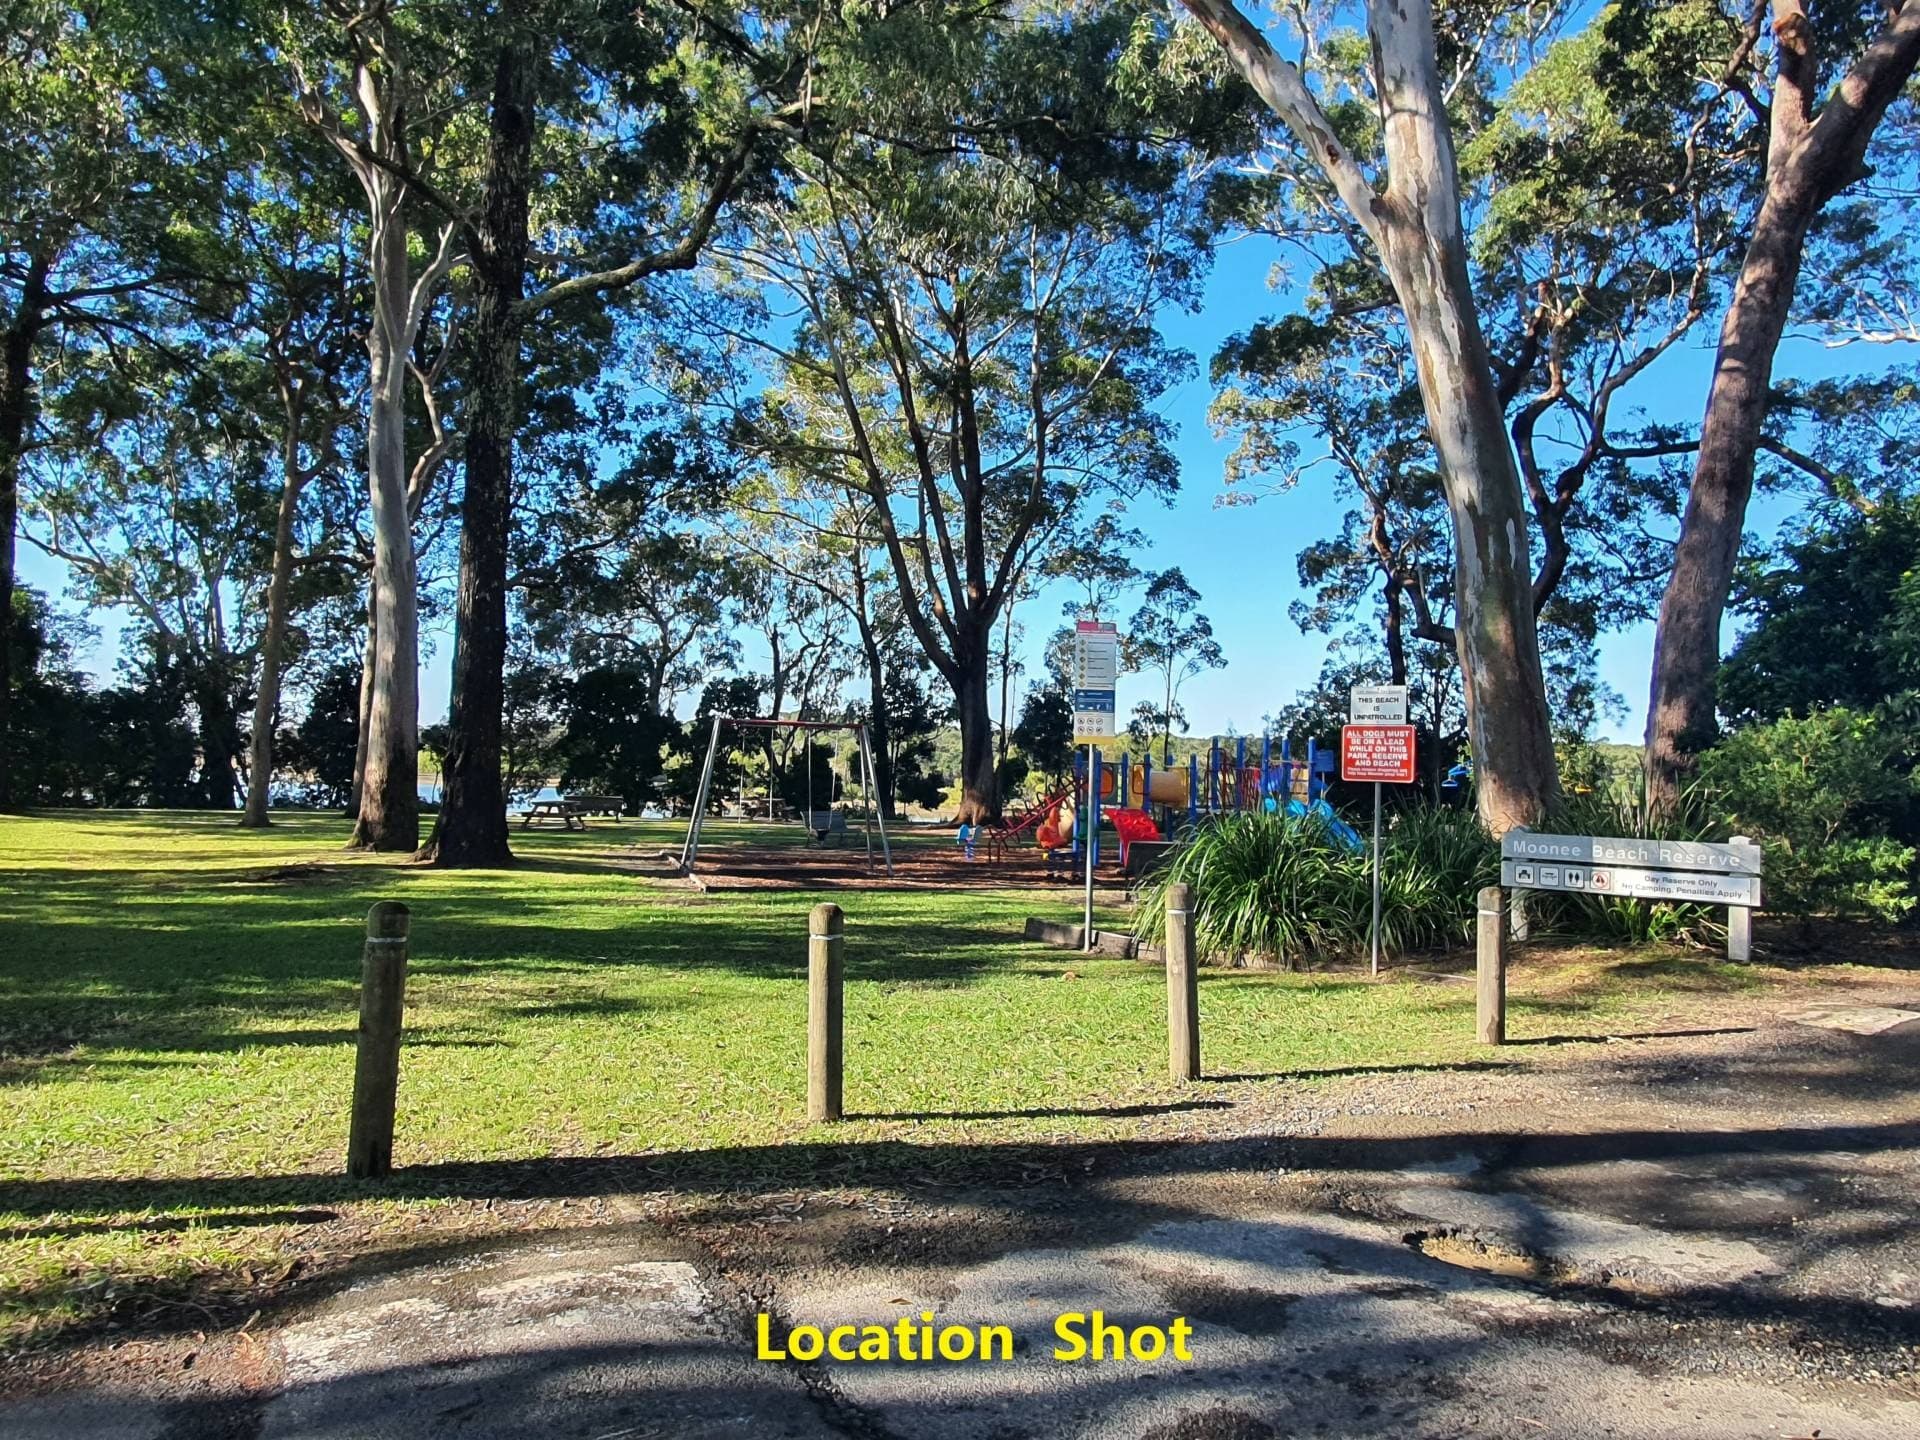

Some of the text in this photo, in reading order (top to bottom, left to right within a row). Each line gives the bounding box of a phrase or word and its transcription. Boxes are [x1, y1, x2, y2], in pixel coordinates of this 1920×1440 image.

[1346, 730, 1362, 738] ALL
[1513, 840, 1740, 867] Moonee Beach Reserve
[1644, 875, 1718, 888] Day Reserve Only
[1717, 890, 1742, 899] Apply
